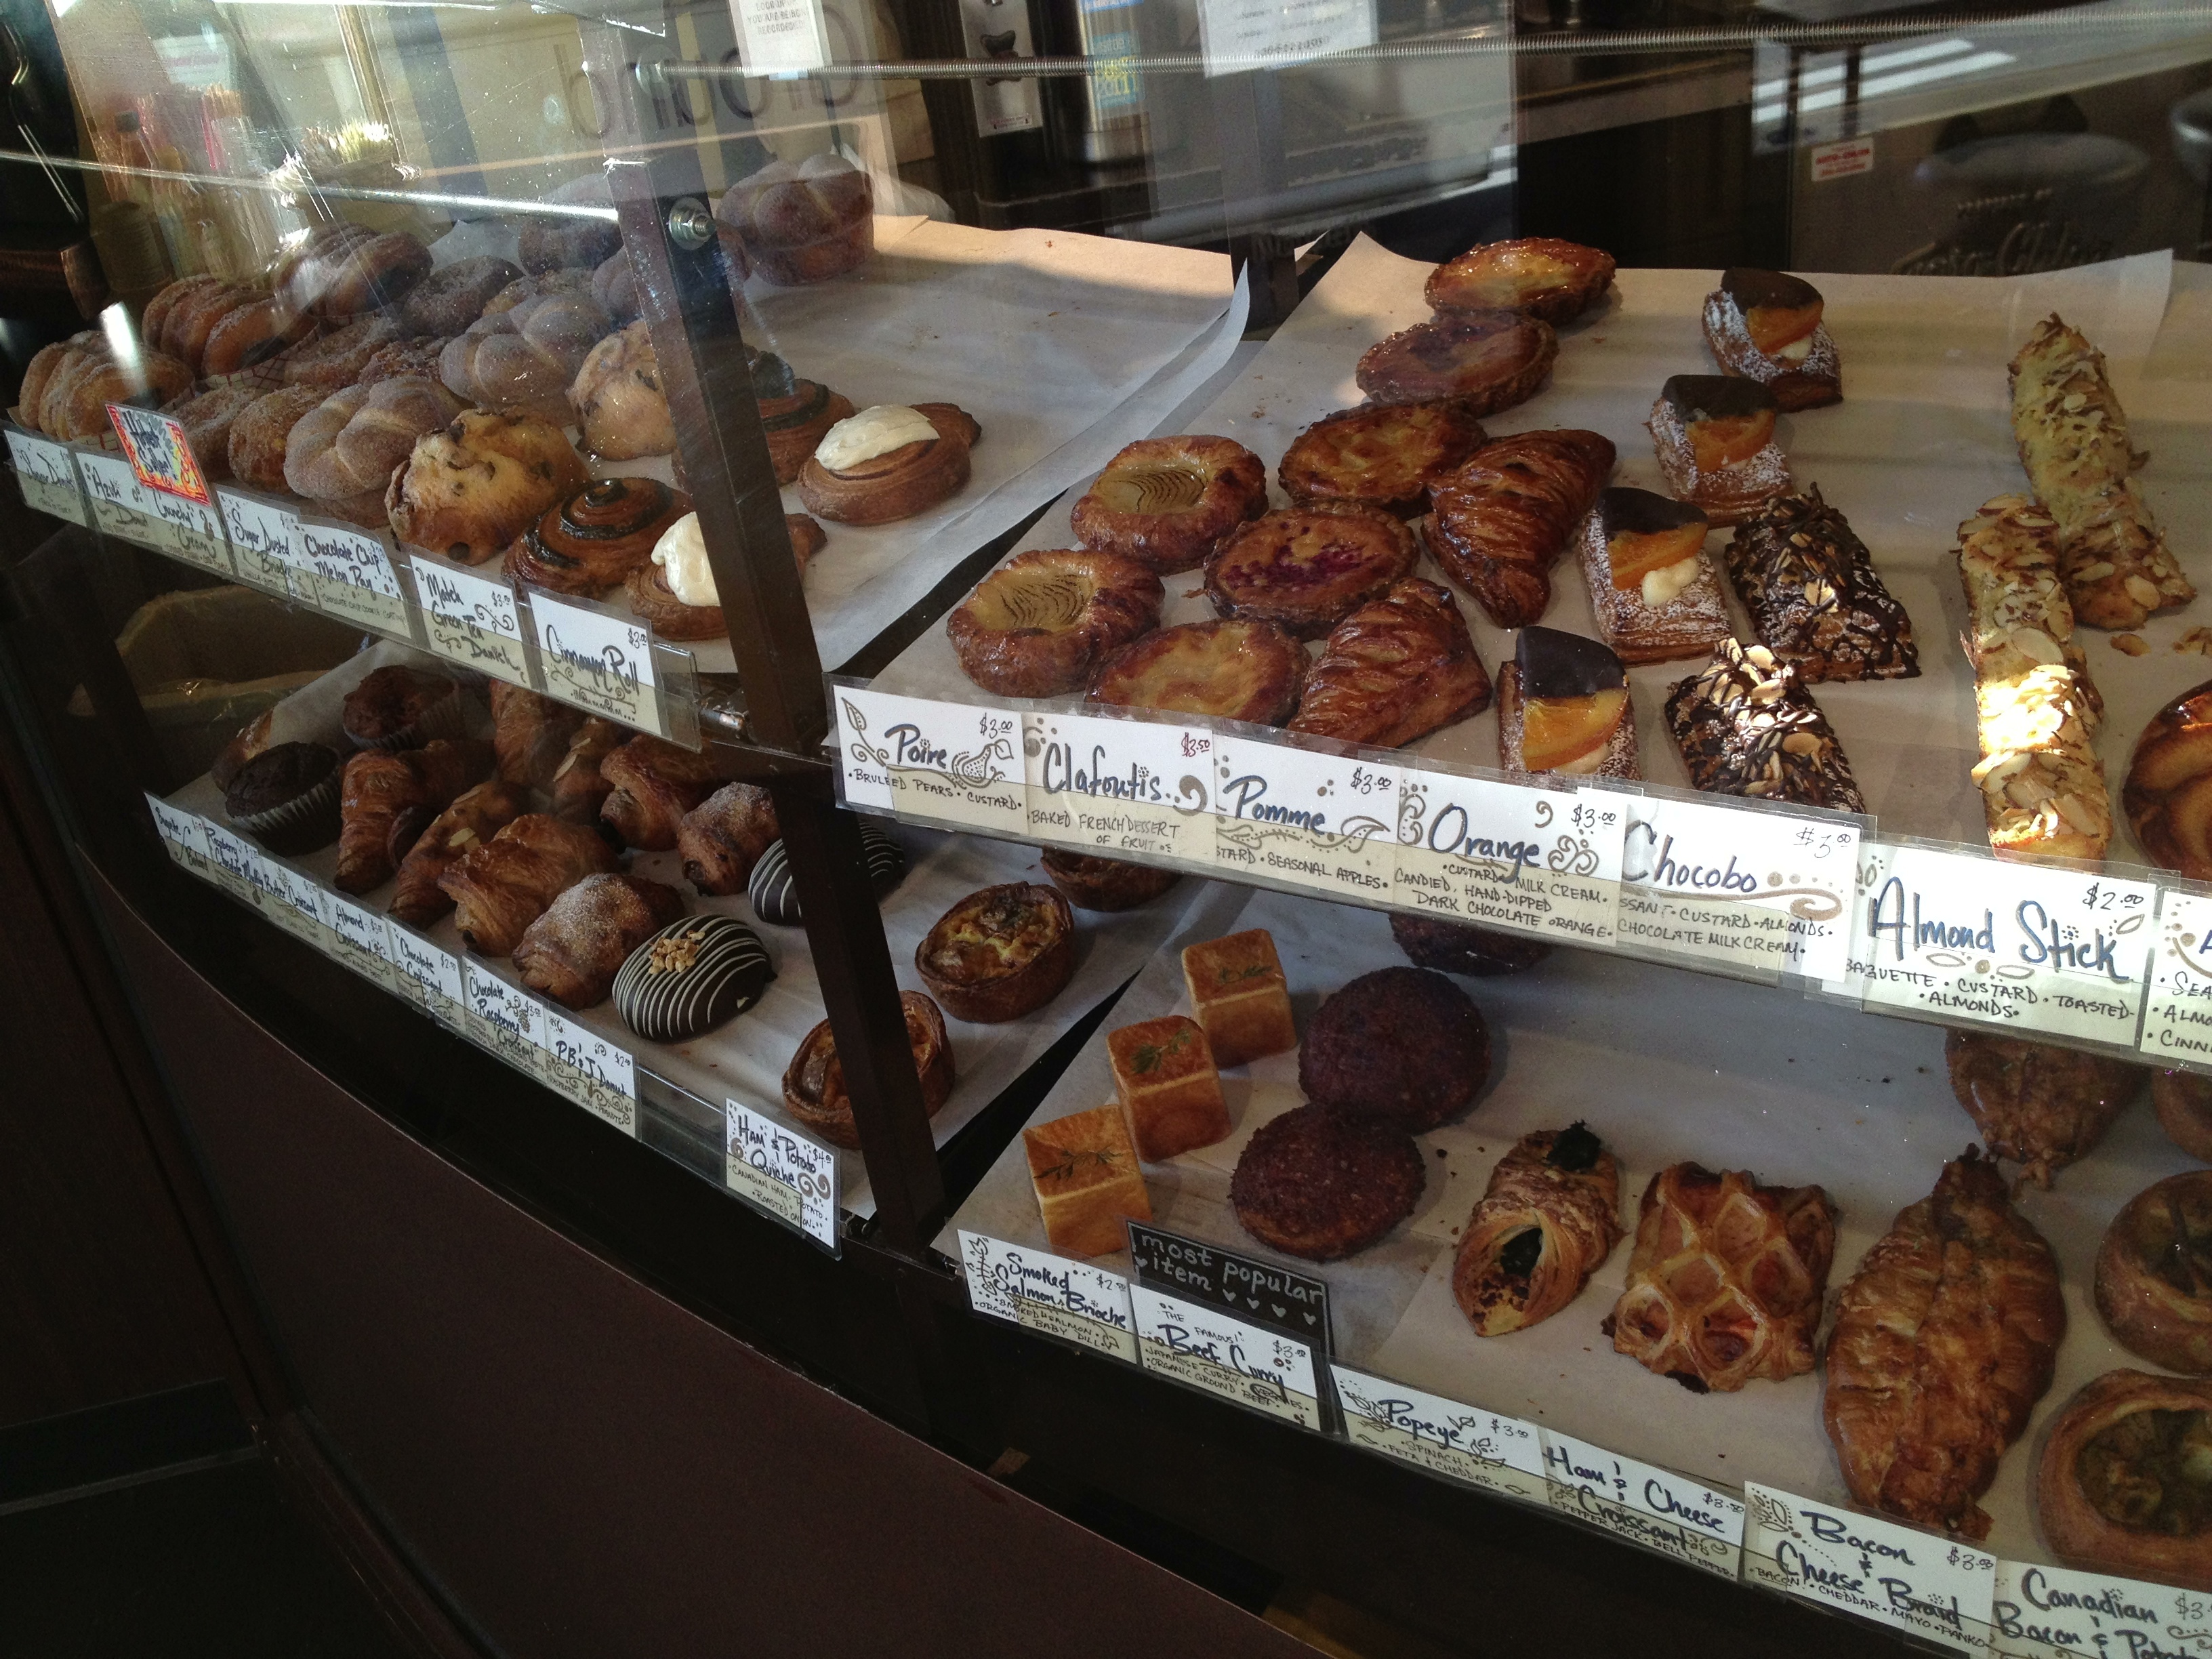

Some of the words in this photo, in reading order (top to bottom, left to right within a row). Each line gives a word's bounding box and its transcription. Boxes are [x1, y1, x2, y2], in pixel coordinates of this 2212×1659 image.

[258, 516, 289, 556] Dusted
[305, 533, 352, 562] Chocolate
[431, 600, 463, 630] Green
[602, 645, 639, 696] Roll
[979, 712, 1012, 735] $3.00
[884, 723, 947, 769] Poire
[1182, 732, 1210, 757] $3.50
[1044, 743, 1162, 802] Clafoutis
[1351, 767, 1391, 794] $3.00
[913, 779, 953, 797] PEARS
[968, 792, 1017, 810] CUSTARD
[1223, 775, 1325, 836] Pomme
[1031, 810, 1071, 827] BAKED
[1079, 815, 1126, 833] FRENCH
[1127, 819, 1181, 839] DESSERT
[1572, 804, 1616, 828] $3.00
[1096, 834, 1109, 844] OF
[1121, 836, 1155, 851] FRUIT
[1429, 802, 1540, 883] Orange
[1622, 819, 1757, 893] Chocobo
[1268, 852, 1332, 876] SEASONAL
[1337, 867, 1380, 889] APPLES
[1449, 864, 1498, 882] CUSTARD
[1515, 877, 1546, 893] MILK
[1551, 884, 1600, 903] CREAM
[1412, 890, 1460, 912] DARK
[1468, 901, 1540, 926] CHOCOLATE
[1465, 885, 1552, 912] HAND-DIPPED
[2083, 883, 2144, 911] $2.00
[1618, 918, 1703, 944] CHOCOLATE
[1708, 933, 1740, 948] MILK
[1680, 908, 1750, 928] CUSTARD
[1759, 917, 1824, 937] ALMONDS
[1868, 876, 1995, 961] Almond
[2017, 901, 2133, 983] Stick
[400, 937, 434, 975] Chocolate
[469, 976, 504, 1000] Chocolate
[1929, 991, 2013, 1018] ALMONDS
[1958, 978, 2037, 1004] CUSTARD
[2053, 995, 2130, 1019] TOASTED
[556, 1040, 577, 1068] PB
[585, 1057, 596, 1079] J
[2160, 1029, 2212, 1053] CINN
[750, 1148, 796, 1189] Quiche
[778, 1135, 817, 1174] Potato
[732, 1164, 768, 1189] CANADIAN
[771, 1185, 788, 1201] HAM
[794, 1195, 823, 1219] POTATO
[754, 1189, 788, 1216] ROASTED
[1006, 1252, 1069, 1292] Smoked
[1142, 1234, 1212, 1266] most
[1223, 1262, 1323, 1304] popular
[1153, 1253, 1212, 1291] item
[994, 1263, 1058, 1305] Salmon
[1061, 1290, 1126, 1329] Brioche
[1033, 1319, 1067, 1335] BABY
[1075, 1329, 1099, 1347] DILL
[1164, 1311, 1184, 1322] THE
[1147, 1347, 1198, 1370] JAPANESE
[1204, 1367, 1240, 1385] CURRY
[1150, 1357, 1192, 1376] ORGANIC
[1195, 1373, 1235, 1393] GROUND
[1157, 1324, 1221, 1366] Beef
[1229, 1345, 1288, 1404] Curry
[1378, 1399, 1464, 1450] Popeye
[1388, 1443, 1419, 1462] FETA
[1435, 1461, 1493, 1486] CHEDDAR
[1406, 1441, 1463, 1466] SPINACH
[1542, 1446, 1606, 1486] Ham
[1644, 1479, 1725, 1533] Cheese
[1562, 1502, 1610, 1526] PEPPER
[1613, 1524, 1642, 1540] JACK
[1652, 1538, 1685, 1558] BELL
[1578, 1484, 1694, 1551] Croissant
[1799, 1510, 1917, 1566] Bacon
[1776, 1540, 1865, 1594] Cheese
[1878, 1577, 1963, 1631] Braid
[2021, 1568, 2158, 1624] Canadian
[1818, 1585, 1881, 1612] CHEDDAR
[1891, 1607, 1931, 1628] MAYO
[1938, 1624, 1986, 1648] PANKO
[1992, 1600, 2082, 1645] Bacon
